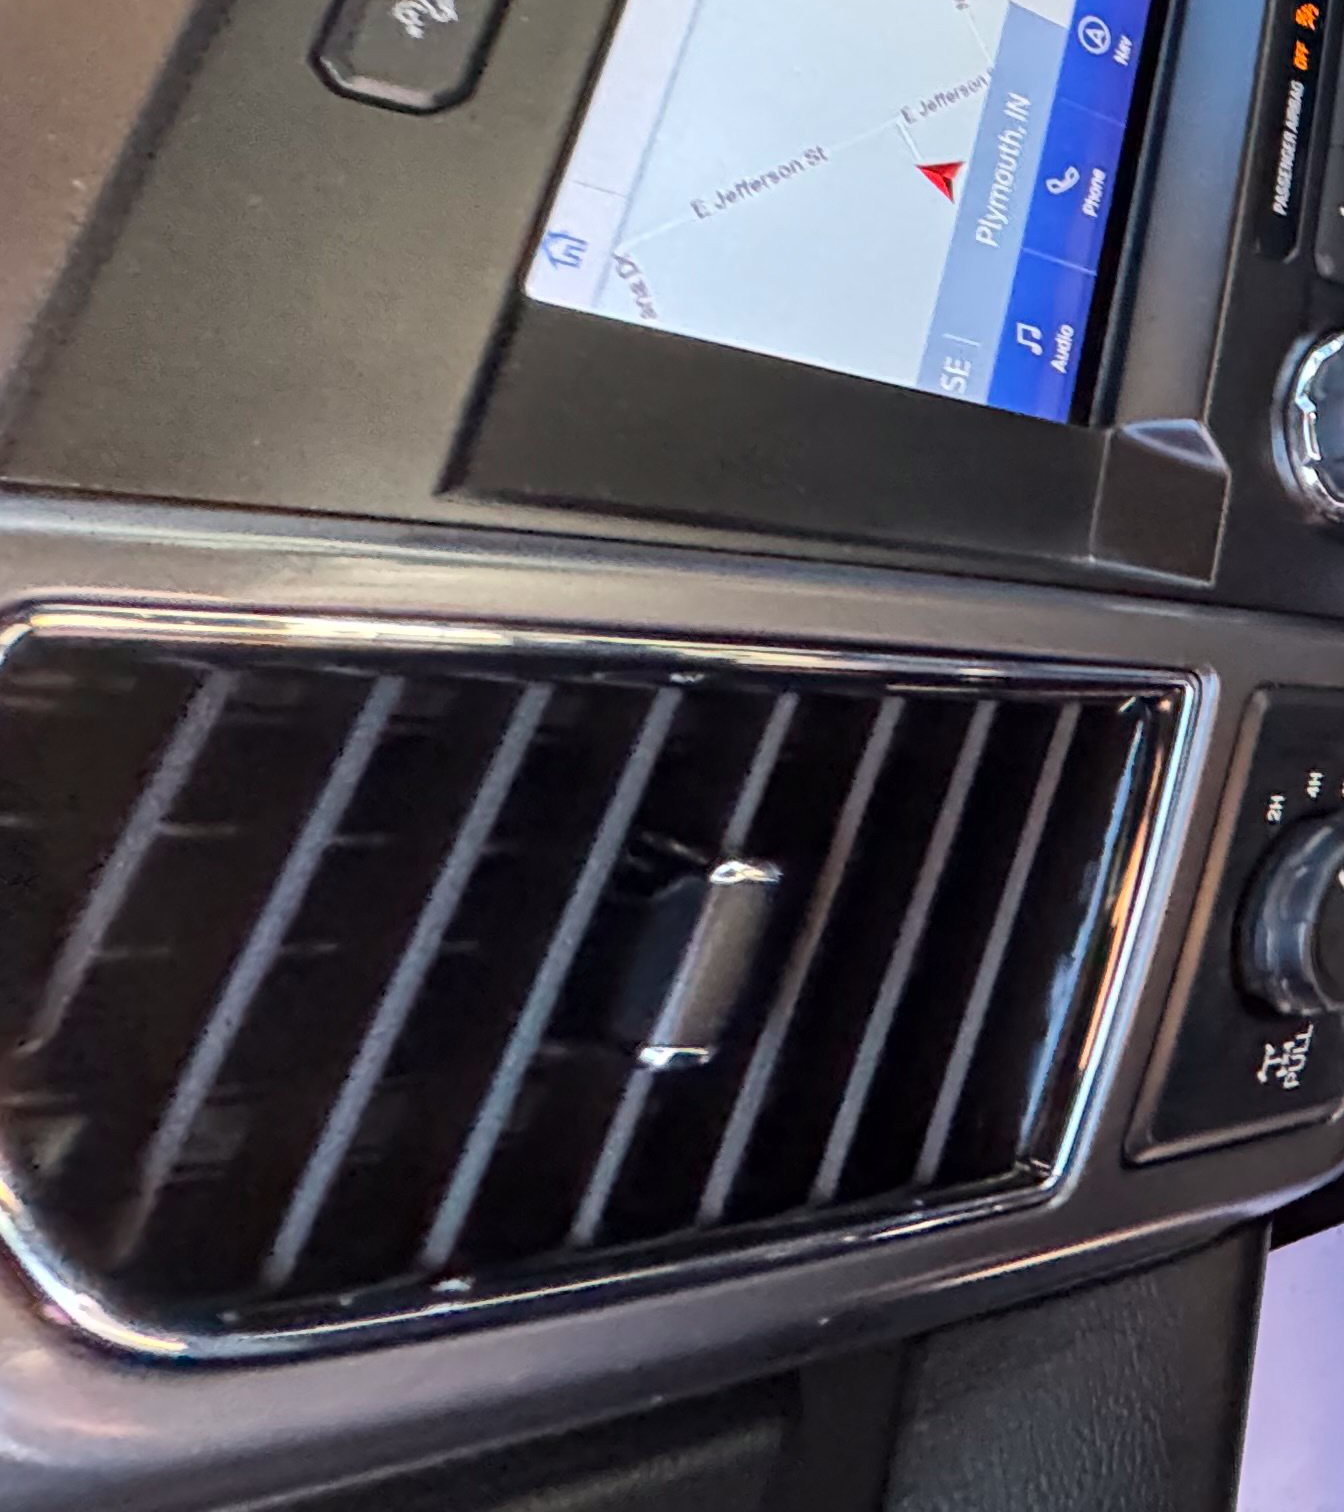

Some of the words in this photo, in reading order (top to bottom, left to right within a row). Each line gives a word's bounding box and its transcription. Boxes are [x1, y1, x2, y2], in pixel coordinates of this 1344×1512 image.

[1114, 35, 1133, 66] Nav
[1293, 40, 1310, 70] OFF
[901, 106, 917, 124] E
[919, 75, 990, 119] Jefferson
[1284, 80, 1304, 135] AIRBAG
[690, 198, 711, 219] E
[714, 159, 805, 210] Jefferson
[803, 145, 829, 166] St
[976, 127, 1028, 248] Plymouth,
[1003, 91, 1032, 124] IN
[1082, 168, 1107, 218] Phone
[1272, 129, 1300, 216] PASSENGER
[1050, 323, 1075, 374] Audio
[940, 356, 972, 394] SE
[1265, 794, 1286, 823] 2H
[1306, 771, 1325, 799] 4H
[1283, 1023, 1314, 1089] PULL
